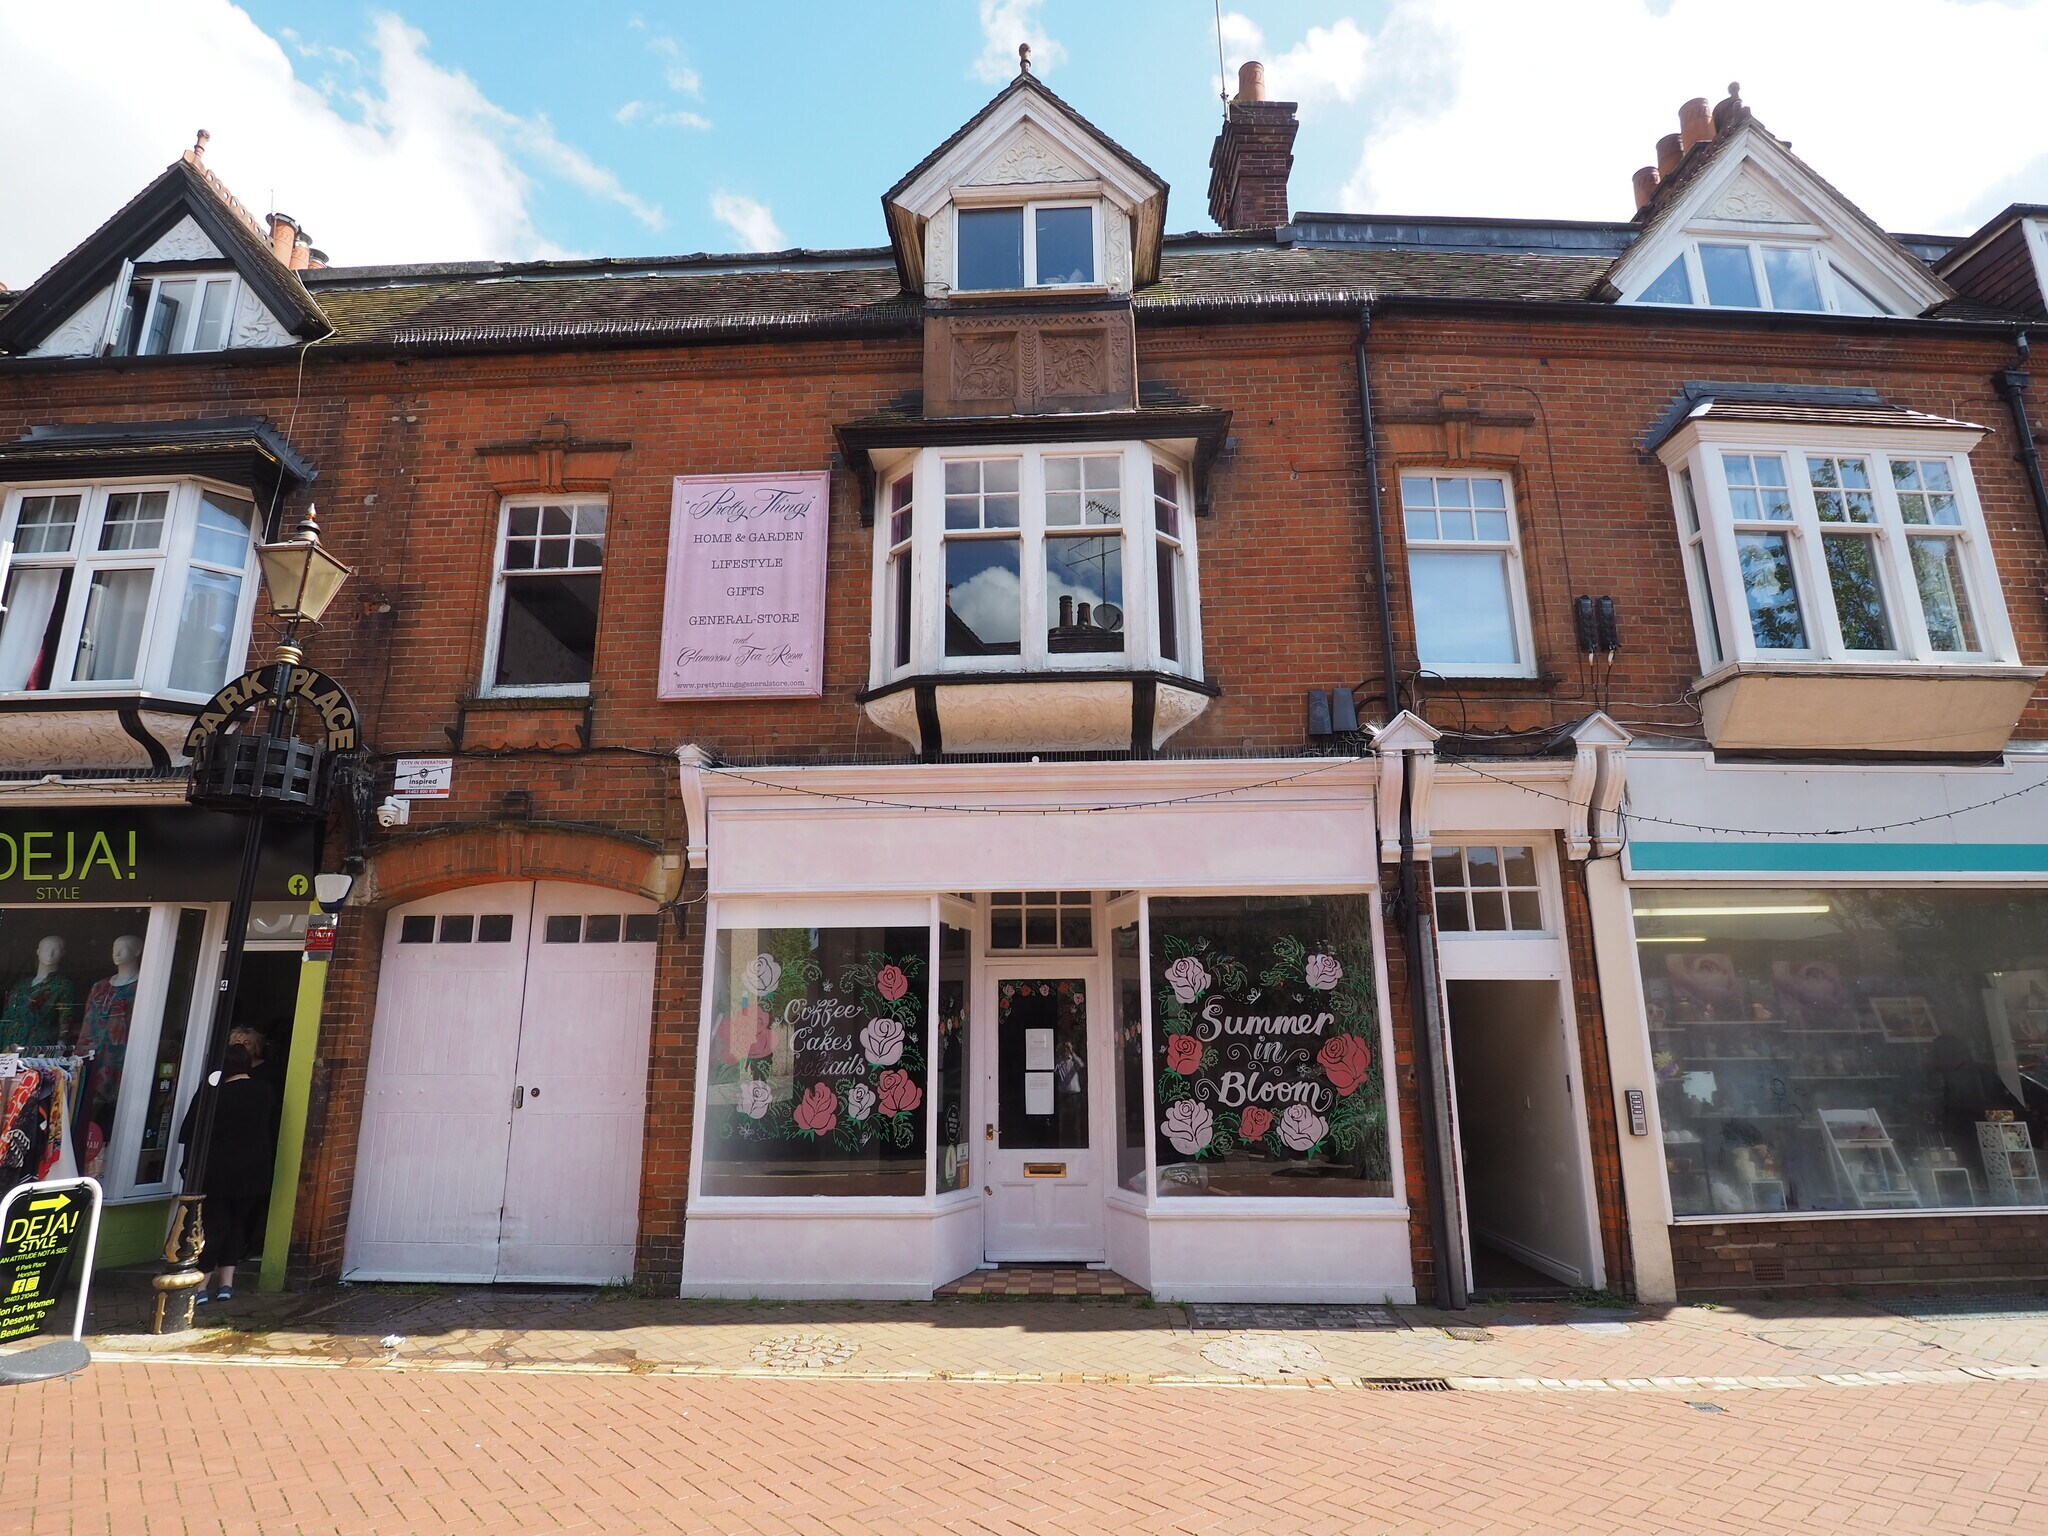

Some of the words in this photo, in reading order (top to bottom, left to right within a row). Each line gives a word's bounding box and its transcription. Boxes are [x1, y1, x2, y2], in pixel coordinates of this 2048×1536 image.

[689, 487, 748, 522] Pretty
[750, 488, 813, 521] Things
[693, 534, 732, 543] HOME
[735, 534, 745, 542] &
[748, 532, 804, 542] GARDEN
[711, 558, 783, 569] LIFESTYLE
[726, 586, 764, 597] GIFTS
[688, 613, 800, 626] GENERAL-STORE
[733, 632, 753, 645] and
[677, 647, 731, 667] Glamorous
[735, 645, 767, 667] Tea
[766, 643, 804, 667] Room
[676, 680, 805, 689] www.prettythingsgeneralstore.com
[187, 670, 268, 748] PARK
[288, 669, 354, 752] PLACE
[36, 887, 80, 900] STYLE
[784, 998, 864, 1027] Coffee
[1197, 998, 1335, 1043] Summer
[790, 1026, 852, 1053] Cakes
[1253, 1035, 1287, 1063] in
[1216, 1070, 1333, 1113] Bloom
[6, 1210, 80, 1244] DEJA!
[18, 1235, 58, 1253] STYLE
[10, 1252, 37, 1262] ATTITUDE
[38, 1249, 50, 1257] NOT
[56, 1246, 68, 1254] SIZE
[17, 1270, 40, 1279] Horsham
[12, 1304, 26, 1314] For
[27, 1298, 55, 1310] Women
[2, 1314, 35, 1327] Deserve
[37, 1311, 45, 1319] To
